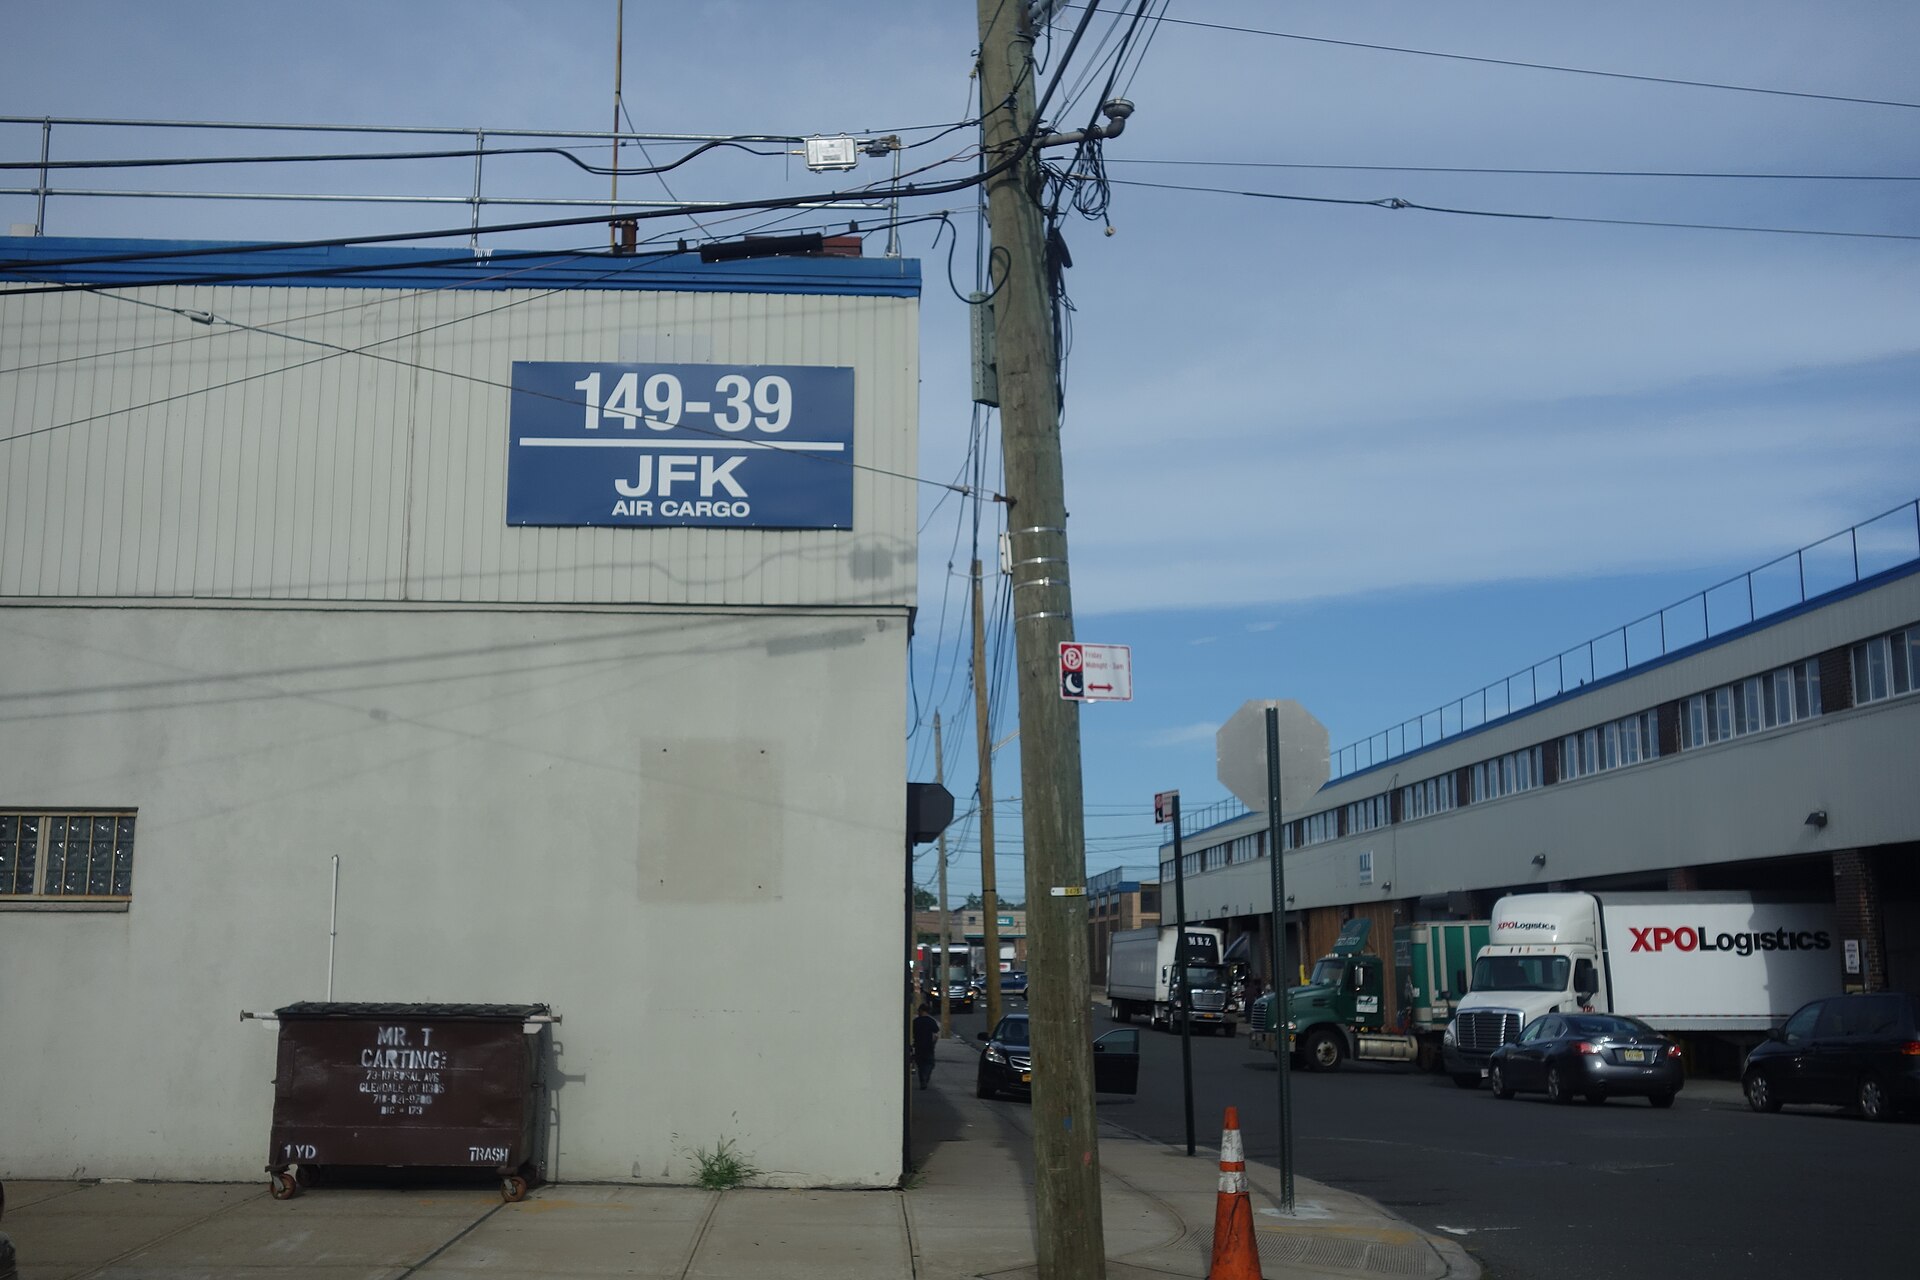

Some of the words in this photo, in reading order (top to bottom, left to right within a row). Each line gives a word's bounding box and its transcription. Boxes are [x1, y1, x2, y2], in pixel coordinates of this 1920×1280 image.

[574, 372, 793, 434] 149-39
[614, 455, 749, 498] JFK
[611, 500, 653, 517] AIR
[659, 500, 750, 518] CARGO
[377, 1026, 412, 1047] MR.
[421, 1027, 434, 1047] T
[361, 1049, 440, 1069] CARTING
[284, 1144, 291, 1158] 1
[295, 1144, 316, 1159] YD
[469, 1146, 508, 1161] TRASH
